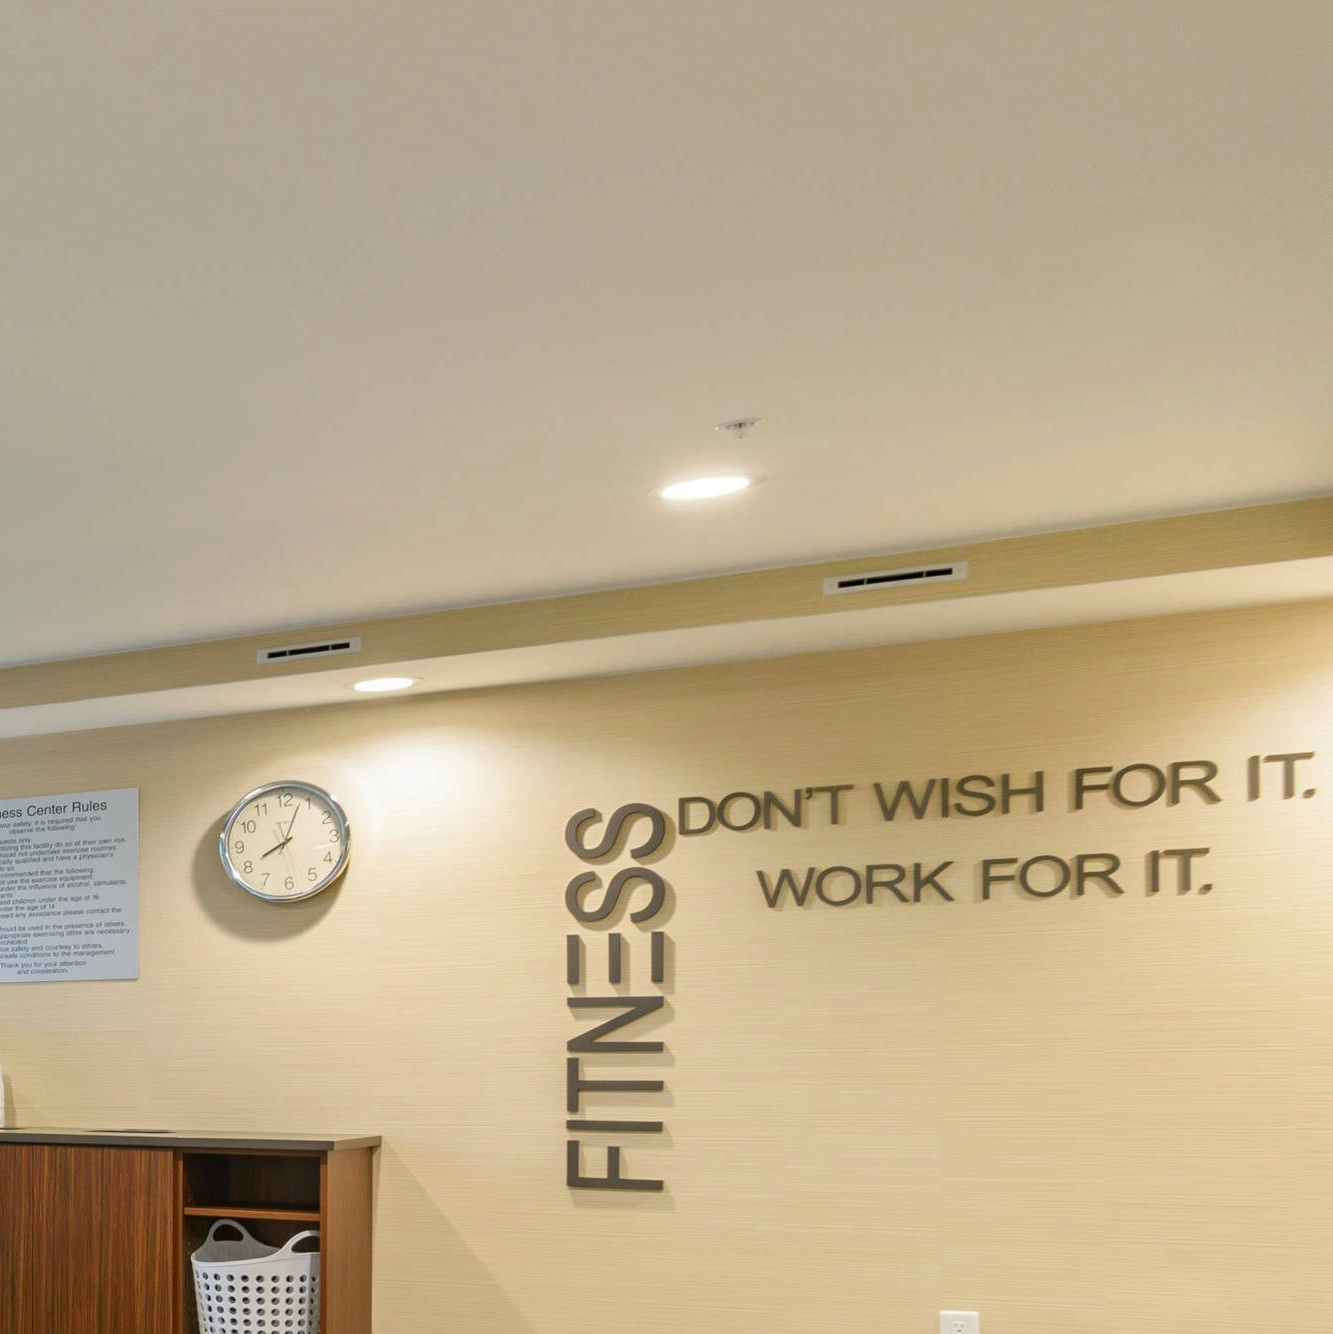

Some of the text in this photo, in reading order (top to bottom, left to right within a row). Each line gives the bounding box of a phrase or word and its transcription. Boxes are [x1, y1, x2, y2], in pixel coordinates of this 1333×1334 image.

[277, 792, 293, 807] 12
[677, 750, 1317, 837] DON'T WISH FOR IT.
[27, 804, 68, 816] Center
[72, 801, 107, 812] Rules
[254, 803, 268, 816] 11
[322, 810, 333, 824] 2
[241, 820, 256, 834] 10
[329, 830, 339, 843] 3
[235, 840, 245, 854] 9
[323, 851, 333, 864] 4
[243, 860, 253, 874] 8
[261, 872, 270, 886] 7
[307, 868, 317, 882] 5
[756, 847, 1214, 909] WORK FOR IT.
[285, 876, 295, 890] 6
[565, 802, 666, 1193] FITNESS
